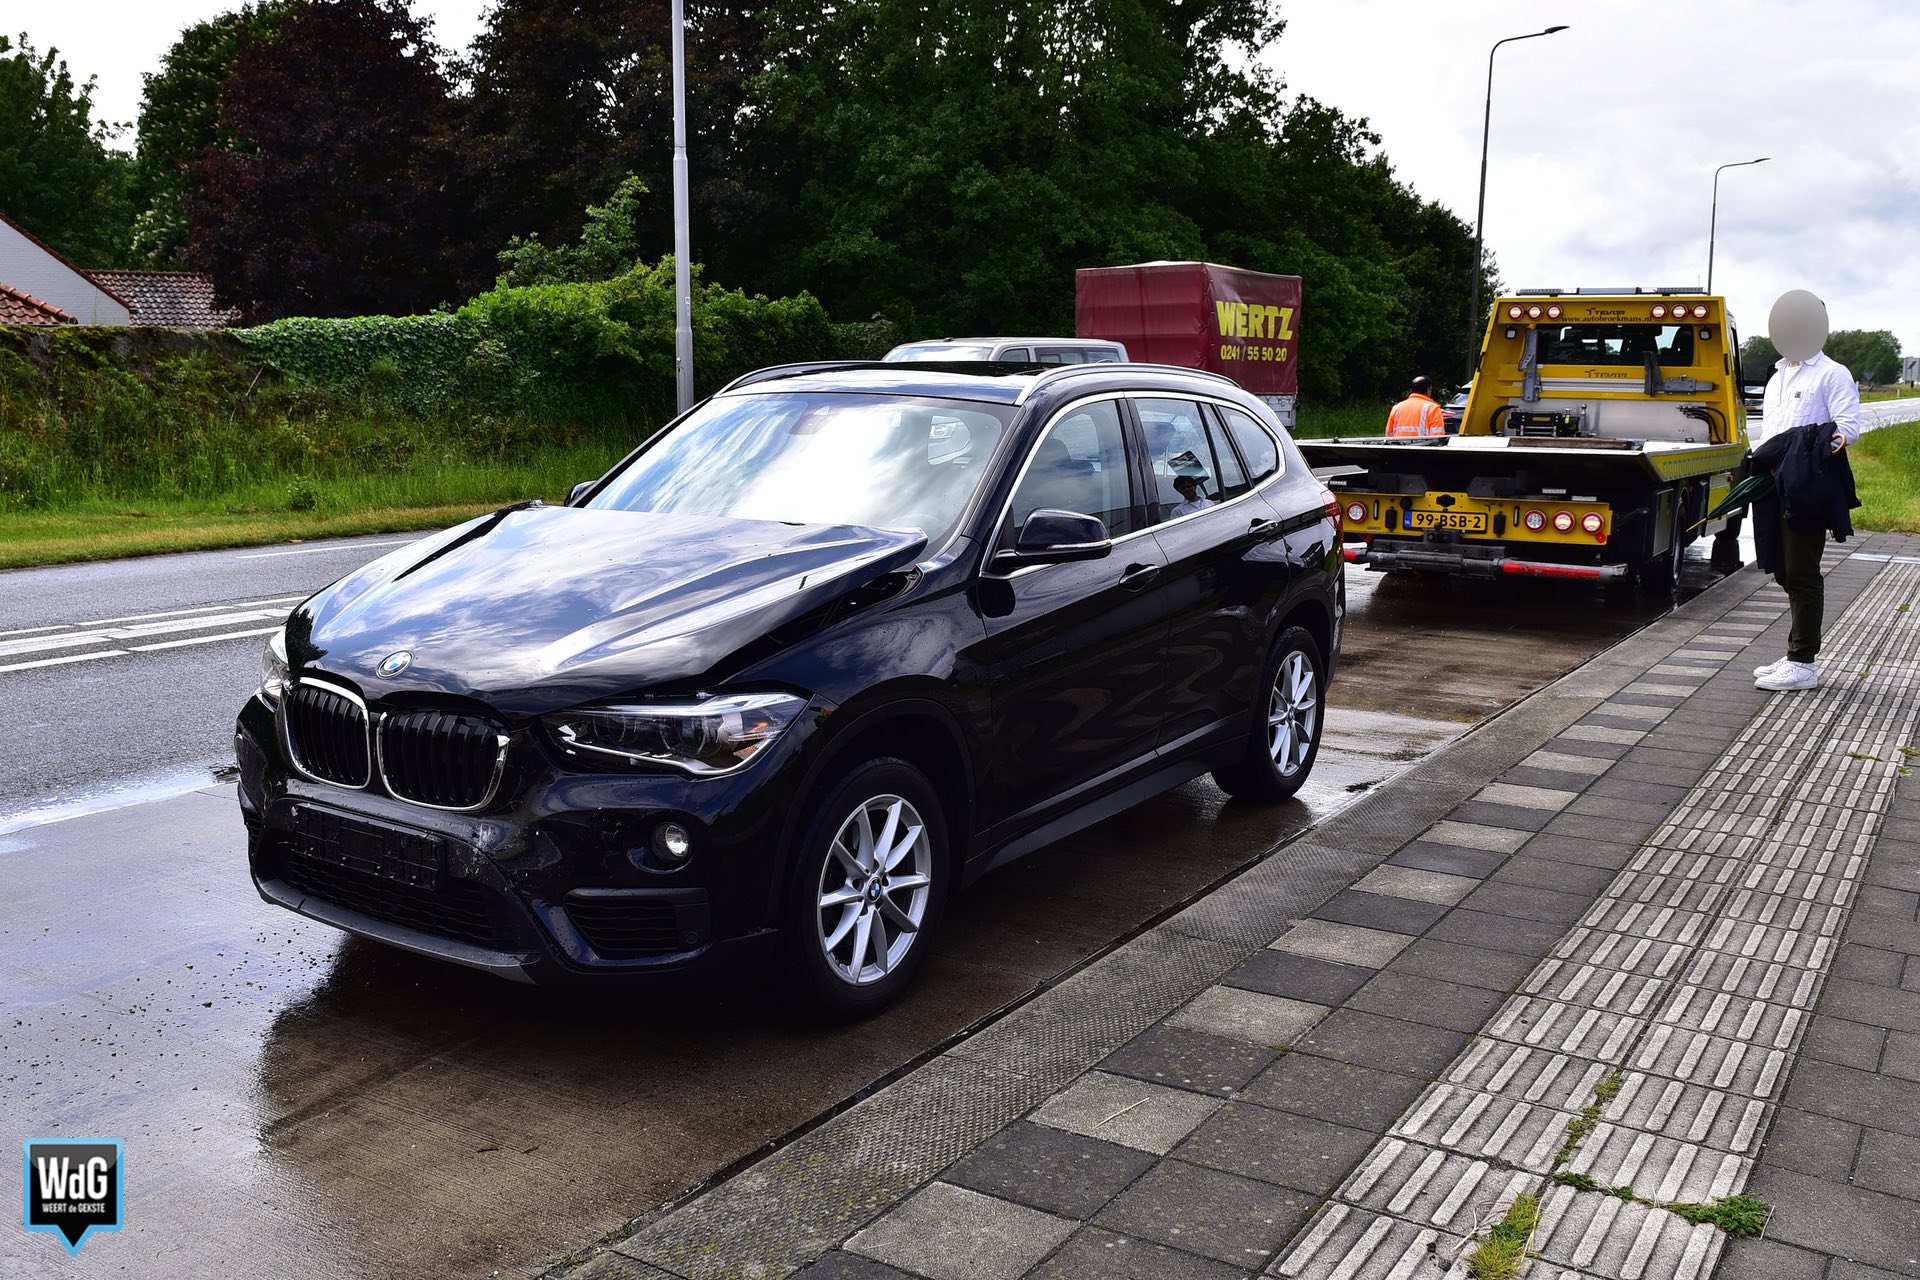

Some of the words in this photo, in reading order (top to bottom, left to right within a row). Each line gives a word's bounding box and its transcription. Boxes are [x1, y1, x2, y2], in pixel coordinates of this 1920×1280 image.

[1215, 301, 1294, 340] WERTZ
[1220, 345, 1241, 360] 0241
[1247, 346, 1260, 361] 55
[1261, 347, 1273, 361] 50
[1275, 347, 1288, 362] 20
[1416, 513, 1481, 529] 99-BSB-2
